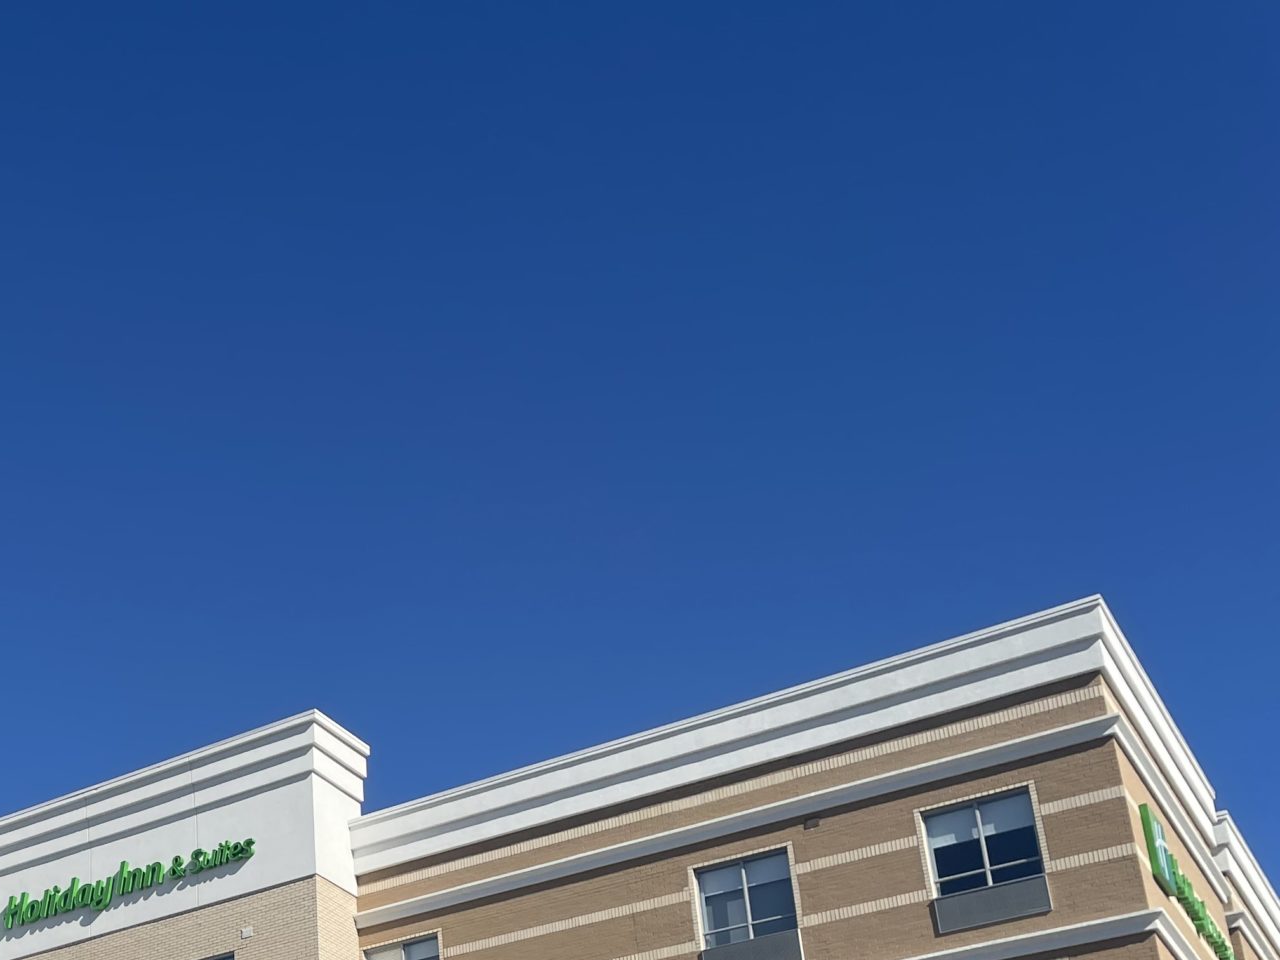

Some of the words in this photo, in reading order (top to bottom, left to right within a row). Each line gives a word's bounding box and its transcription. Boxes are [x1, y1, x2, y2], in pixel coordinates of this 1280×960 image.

[4, 876, 115, 929] Holiday
[115, 861, 164, 896] Inn
[169, 855, 186, 880] &
[189, 838, 256, 874] Suites
